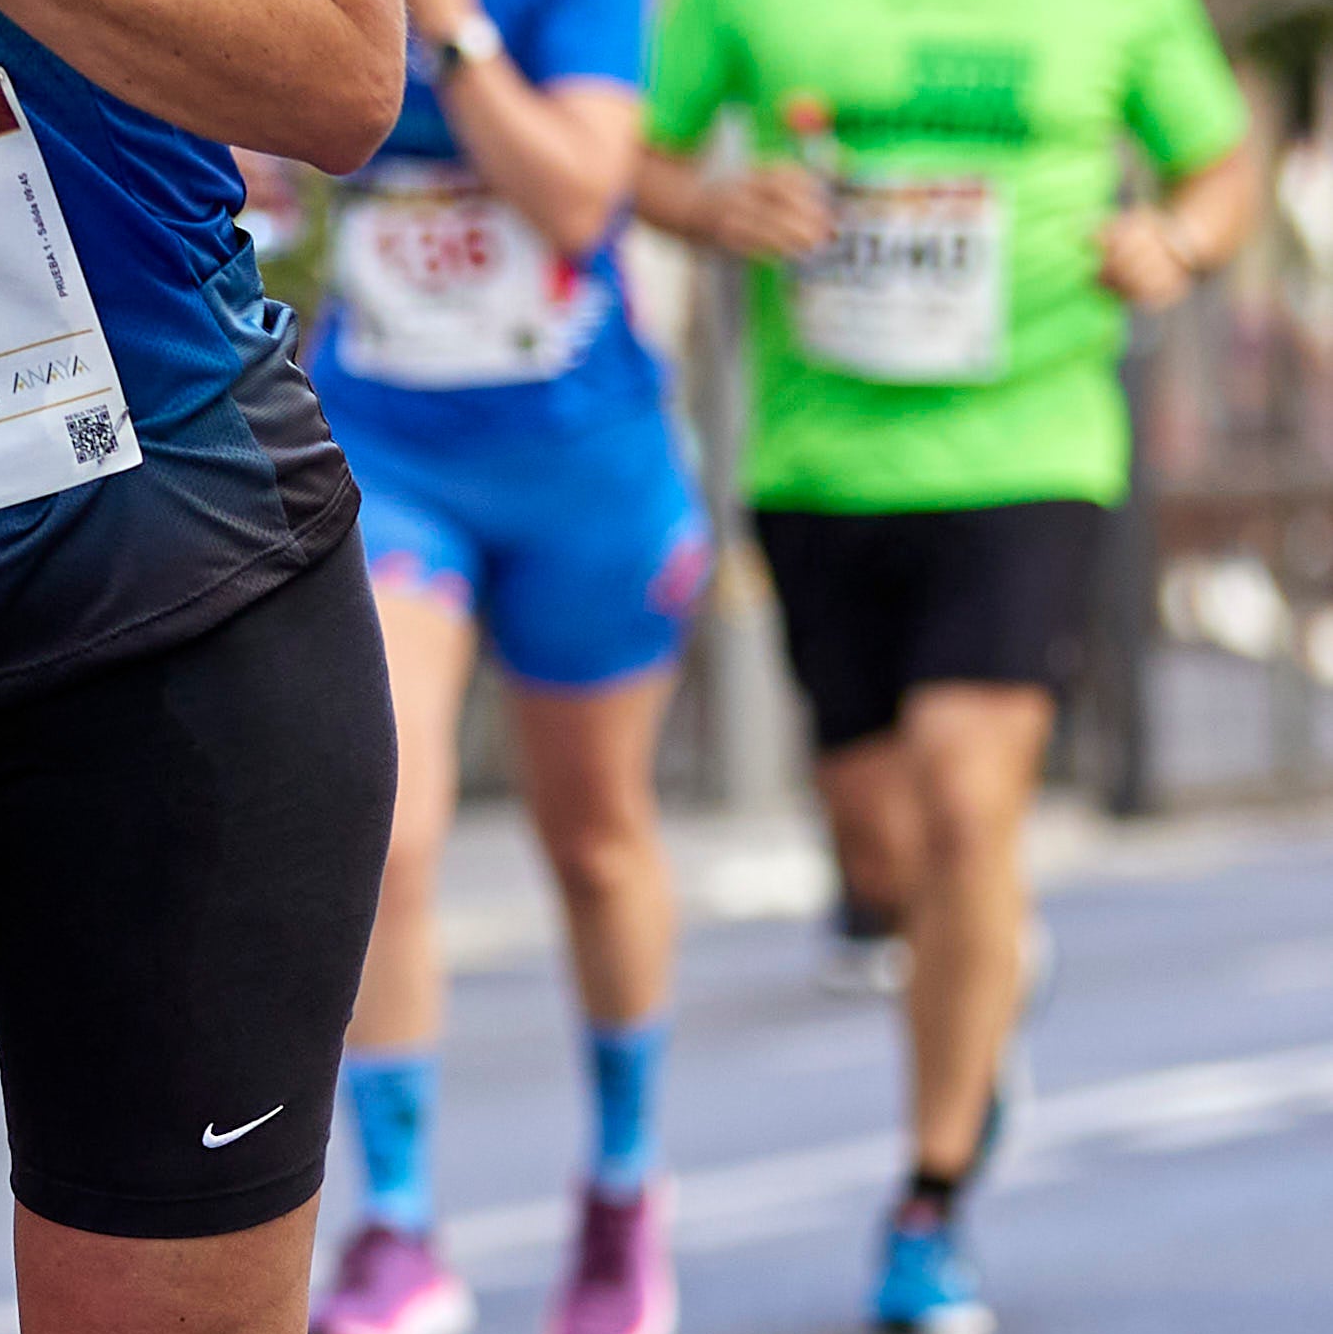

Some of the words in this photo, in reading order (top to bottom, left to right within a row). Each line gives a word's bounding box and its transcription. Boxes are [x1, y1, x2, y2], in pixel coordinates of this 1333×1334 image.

[31, 203, 47, 236] Salida
[46, 252, 68, 298] PRUEBA
[12, 355, 92, 394] ANAYA
